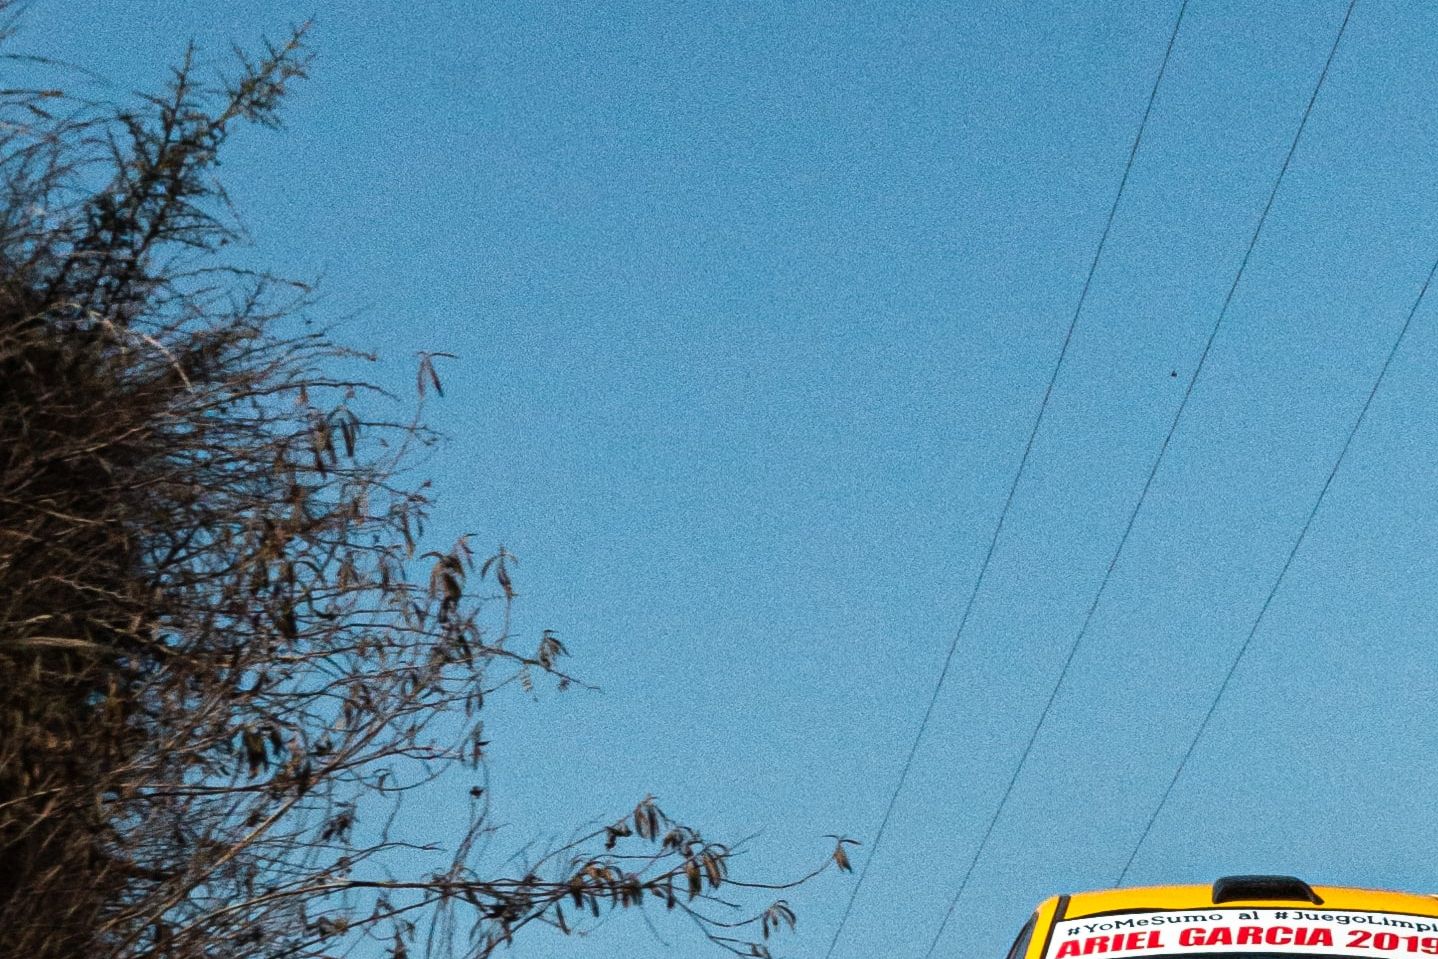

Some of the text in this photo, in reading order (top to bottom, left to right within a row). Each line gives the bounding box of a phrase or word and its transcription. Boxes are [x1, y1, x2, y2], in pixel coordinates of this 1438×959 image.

[1067, 913, 1223, 936] #YoMeSumo
[1238, 911, 1259, 921] al
[1055, 930, 1165, 959] ARIEL
[1178, 927, 1334, 947] GARCIA
